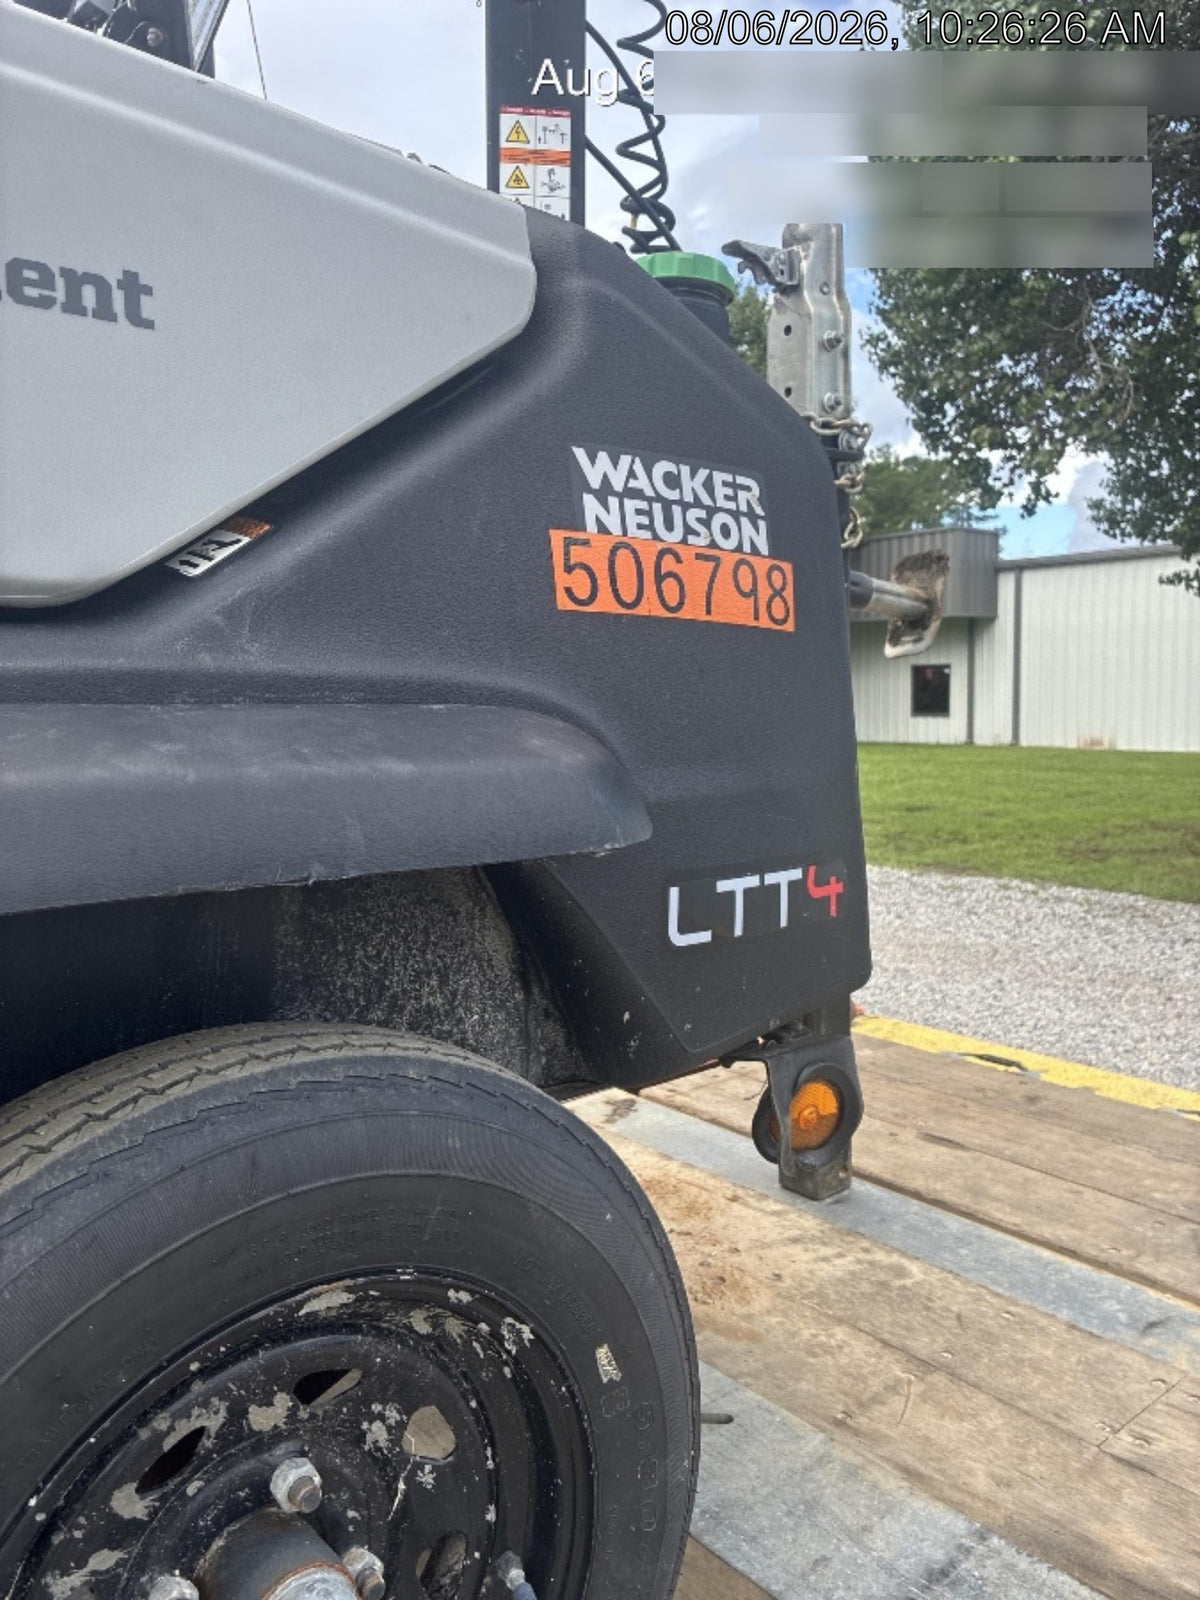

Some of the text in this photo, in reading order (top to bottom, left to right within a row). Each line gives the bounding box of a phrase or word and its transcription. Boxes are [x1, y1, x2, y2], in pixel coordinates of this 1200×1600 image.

[0, 257, 155, 331] ent
[571, 446, 765, 516] WACKER
[582, 492, 769, 556] NEUSON
[563, 536, 791, 626] 506798
